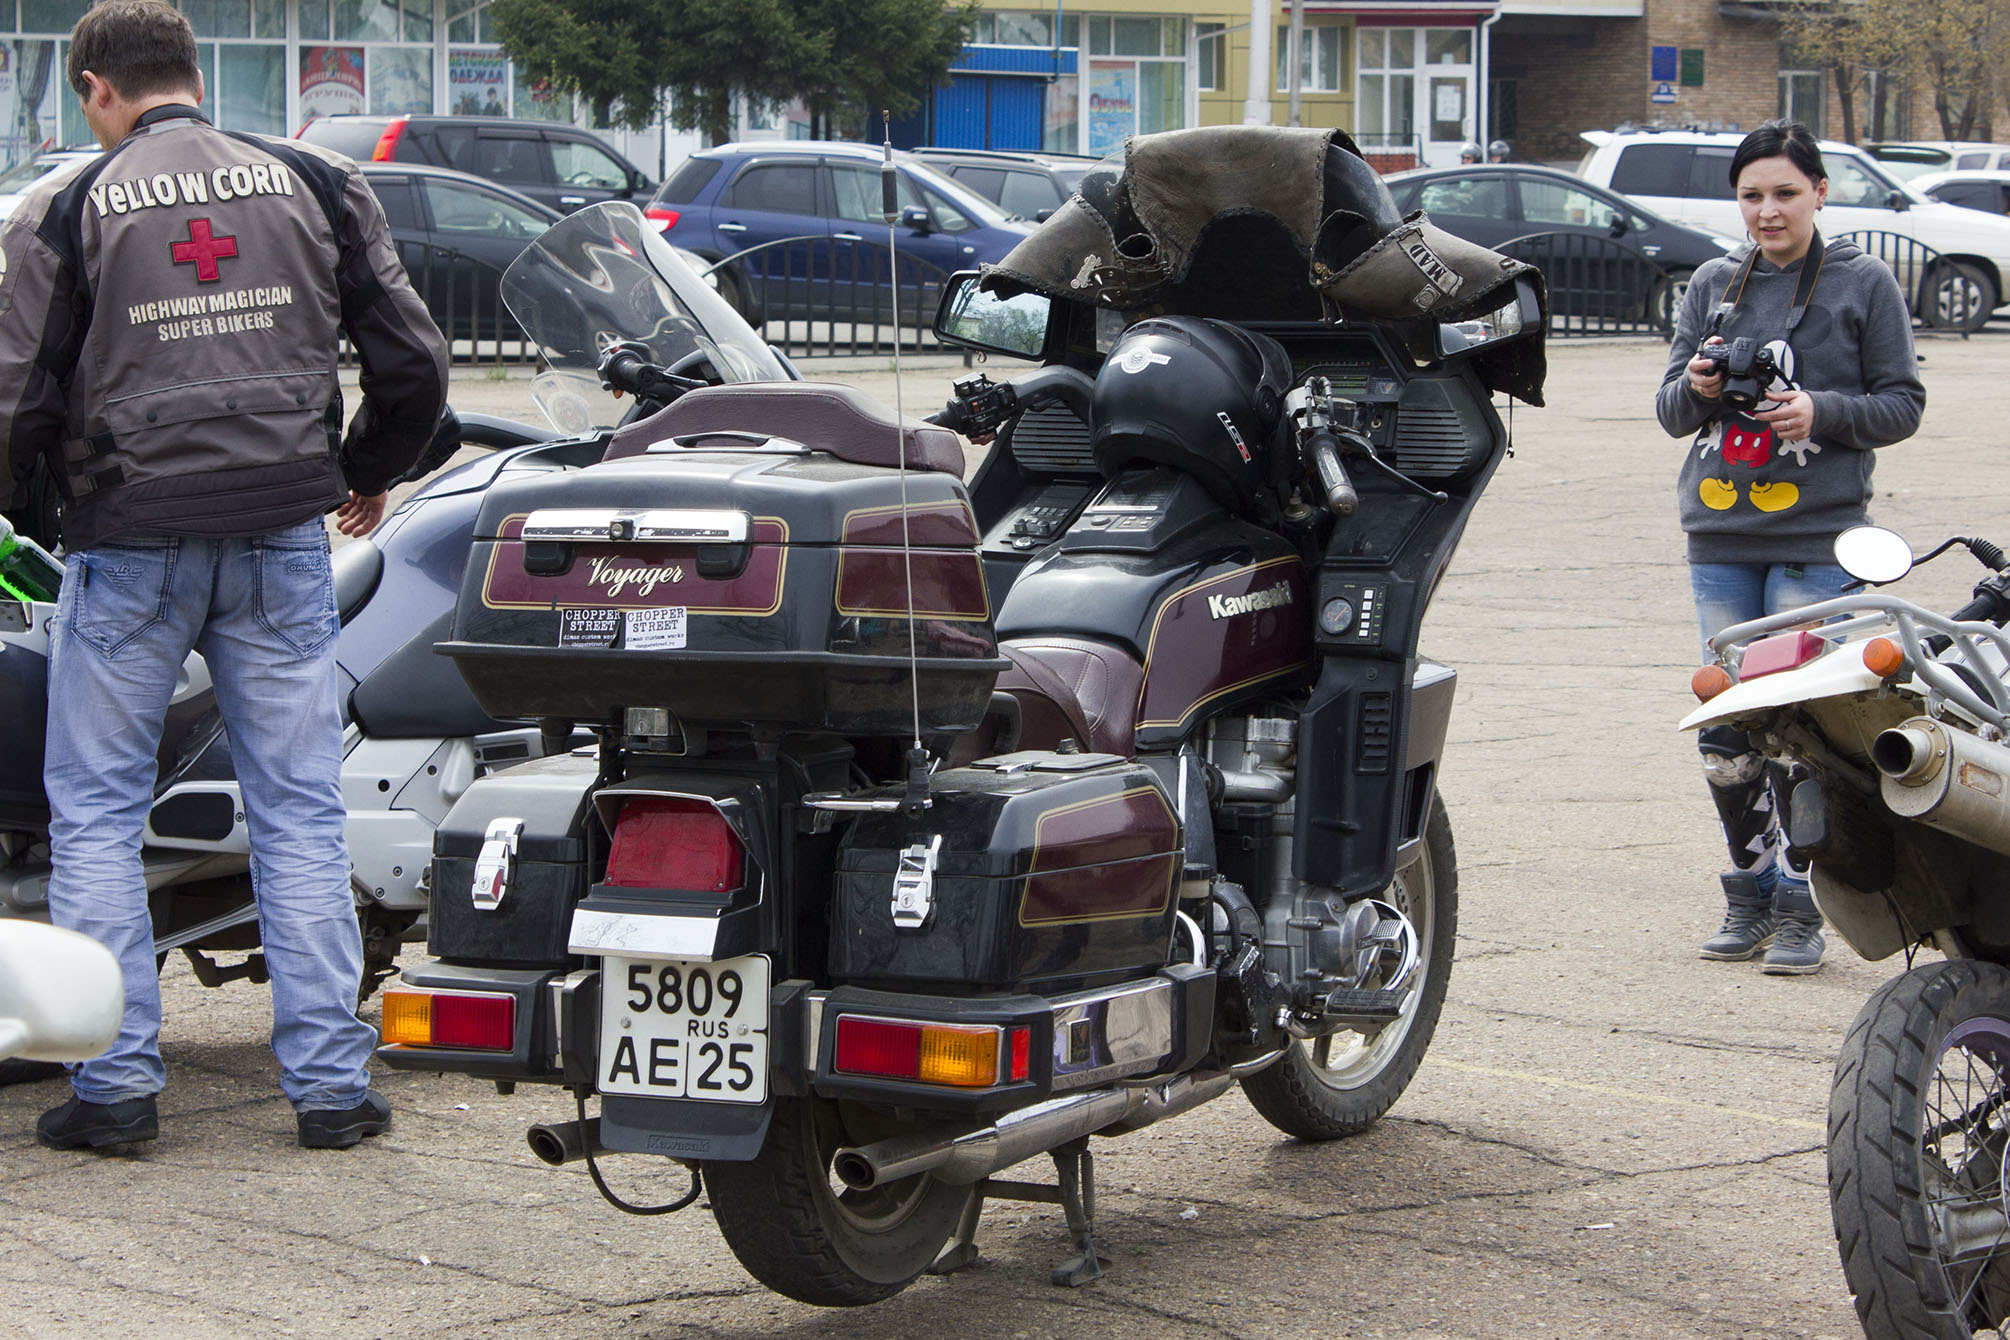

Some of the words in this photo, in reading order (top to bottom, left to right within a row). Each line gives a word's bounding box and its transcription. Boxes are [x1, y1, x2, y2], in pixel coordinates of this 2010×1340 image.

[450, 68, 504, 84] ОДЕЖДА
[1410, 244, 1448, 283] MAD
[128, 295, 207, 325] HIGHWAY
[208, 286, 293, 312] MAGICIAN
[158, 317, 214, 342] SUPER
[215, 311, 274, 334] BIKERS
[586, 554, 685, 598] Voyager
[565, 609, 621, 620] CHOPPER
[627, 607, 685, 622] CHOPPER
[1207, 579, 1293, 620] Kawasaki
[570, 620, 616, 631] STREET
[632, 620, 679, 633] STREET
[627, 964, 744, 1018] 5809
[687, 1019, 730, 1039] RUS
[608, 1036, 679, 1087] AE
[697, 1041, 754, 1092] 25
